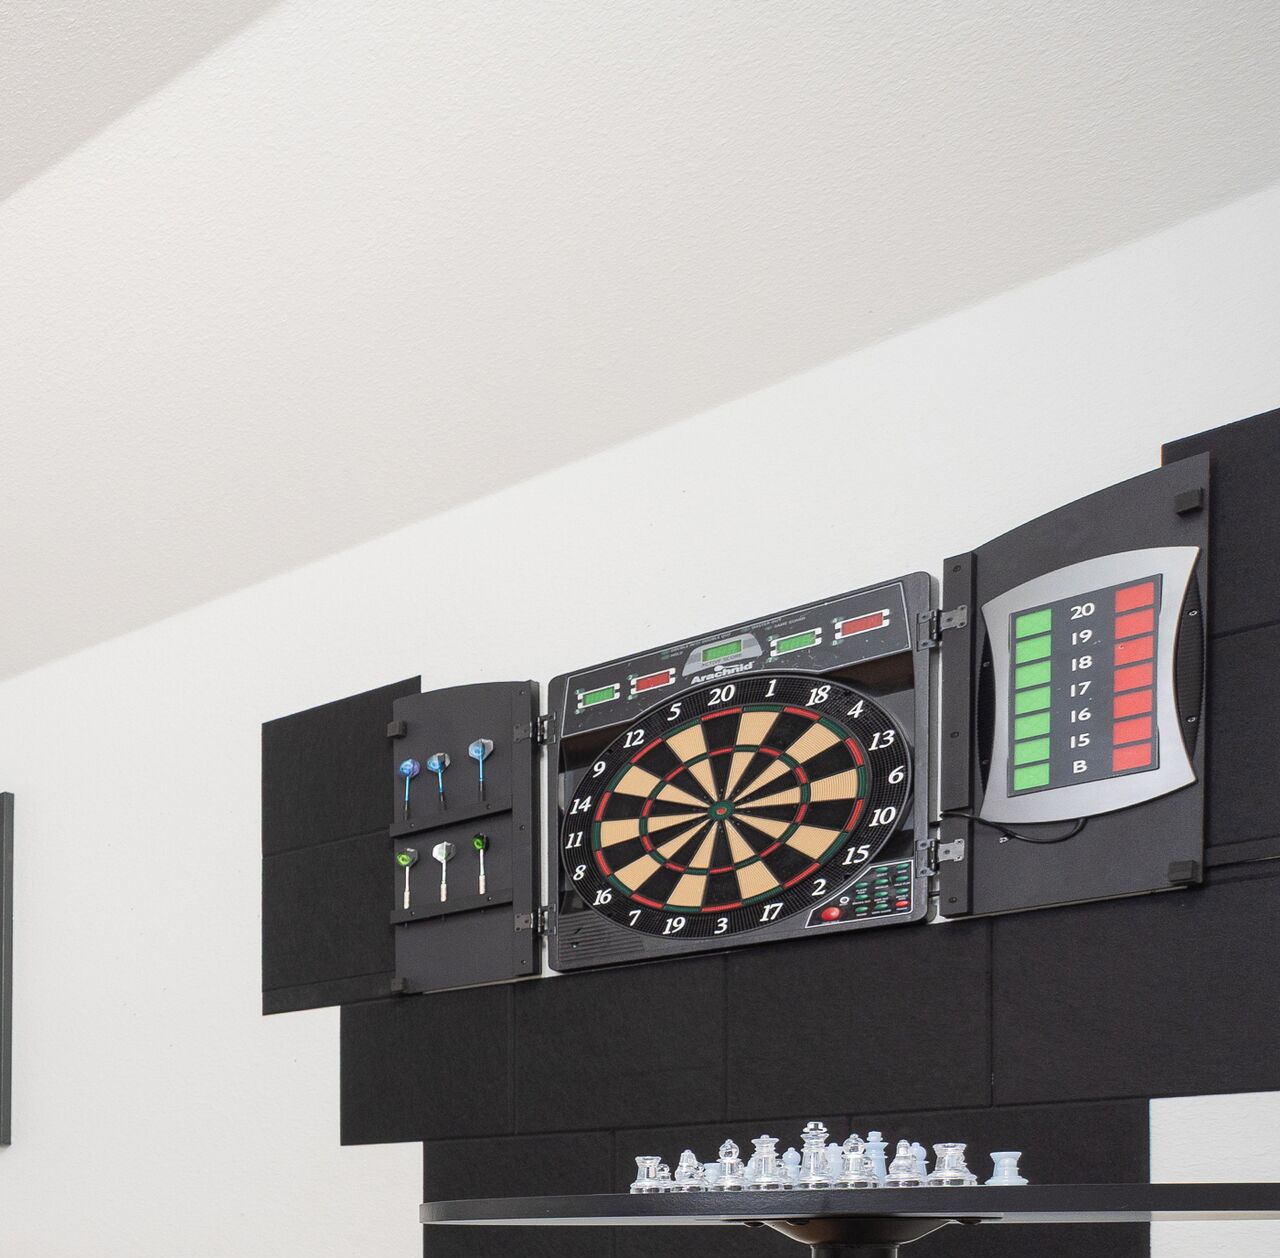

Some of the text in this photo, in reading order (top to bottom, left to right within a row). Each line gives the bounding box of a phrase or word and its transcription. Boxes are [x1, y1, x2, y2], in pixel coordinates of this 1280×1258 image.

[1070, 602, 1095, 621] 20
[1071, 629, 1093, 646] 19
[1071, 655, 1093, 671] 18
[691, 661, 754, 685] Arachnid
[709, 684, 736, 706] 20
[765, 679, 777, 698] 1
[806, 685, 831, 707] 18
[1070, 681, 1092, 697] 17
[666, 702, 682, 721] 5
[847, 700, 864, 719] 4
[1070, 707, 1091, 723] 16
[622, 729, 645, 749] 12
[868, 730, 895, 752] 13
[1070, 732, 1090, 749] 15
[593, 761, 606, 778] 9
[889, 766, 905, 785] 6
[1073, 759, 1088, 774] B
[572, 797, 591, 814] 14
[868, 806, 897, 828] 10
[565, 832, 583, 849] 11
[842, 844, 870, 866] 15
[572, 864, 586, 881] 8
[811, 878, 827, 897] 2
[592, 889, 612, 907] 16
[628, 910, 642, 927] 7
[758, 902, 784, 922] 17
[661, 916, 686, 935] 19
[713, 918, 728, 935] 3
